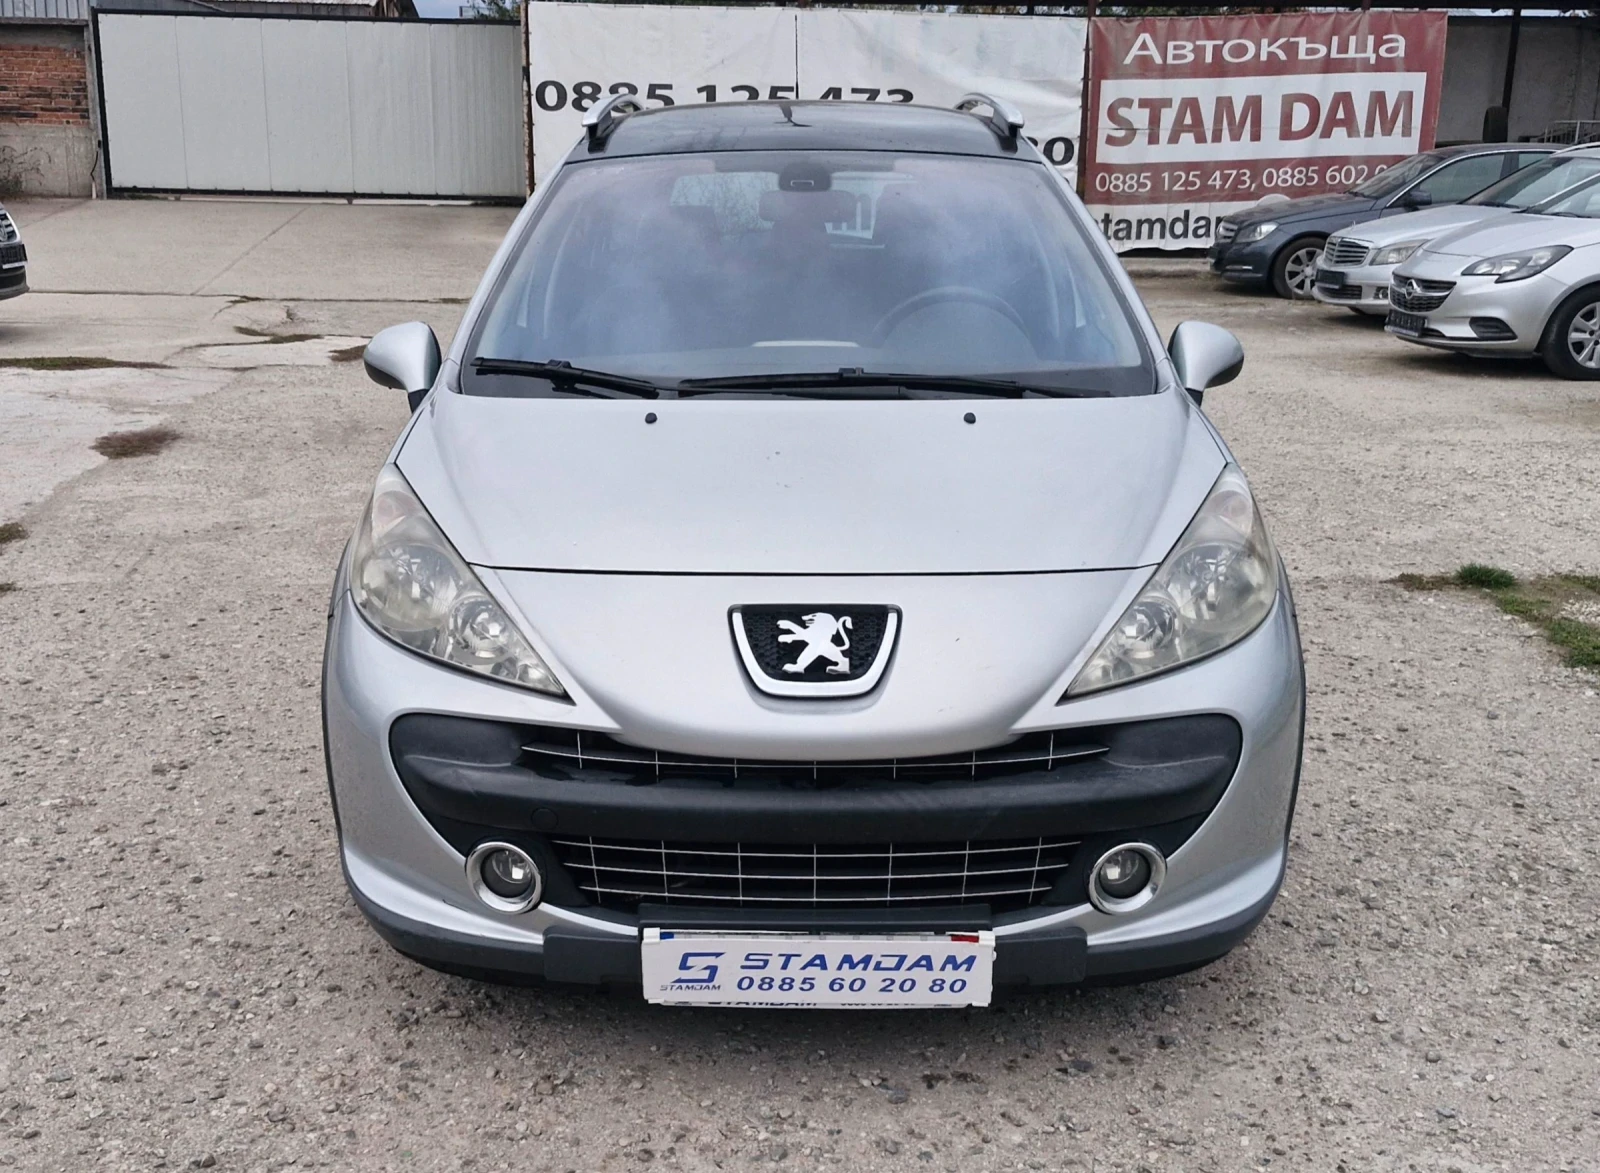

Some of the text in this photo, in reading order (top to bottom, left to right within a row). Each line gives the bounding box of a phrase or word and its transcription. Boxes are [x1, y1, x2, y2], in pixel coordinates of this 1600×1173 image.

[1122, 33, 1406, 65] Автокъща
[1104, 90, 1414, 147] STAM DAM
[1095, 172, 1152, 193] 0885
[1161, 171, 1201, 191] 125
[1207, 169, 1257, 192] 473,
[1262, 166, 1319, 188] 0885
[1325, 164, 1369, 186] 602
[739, 953, 977, 972] STAMDAM
[736, 976, 967, 994] 0885 60 20 80
